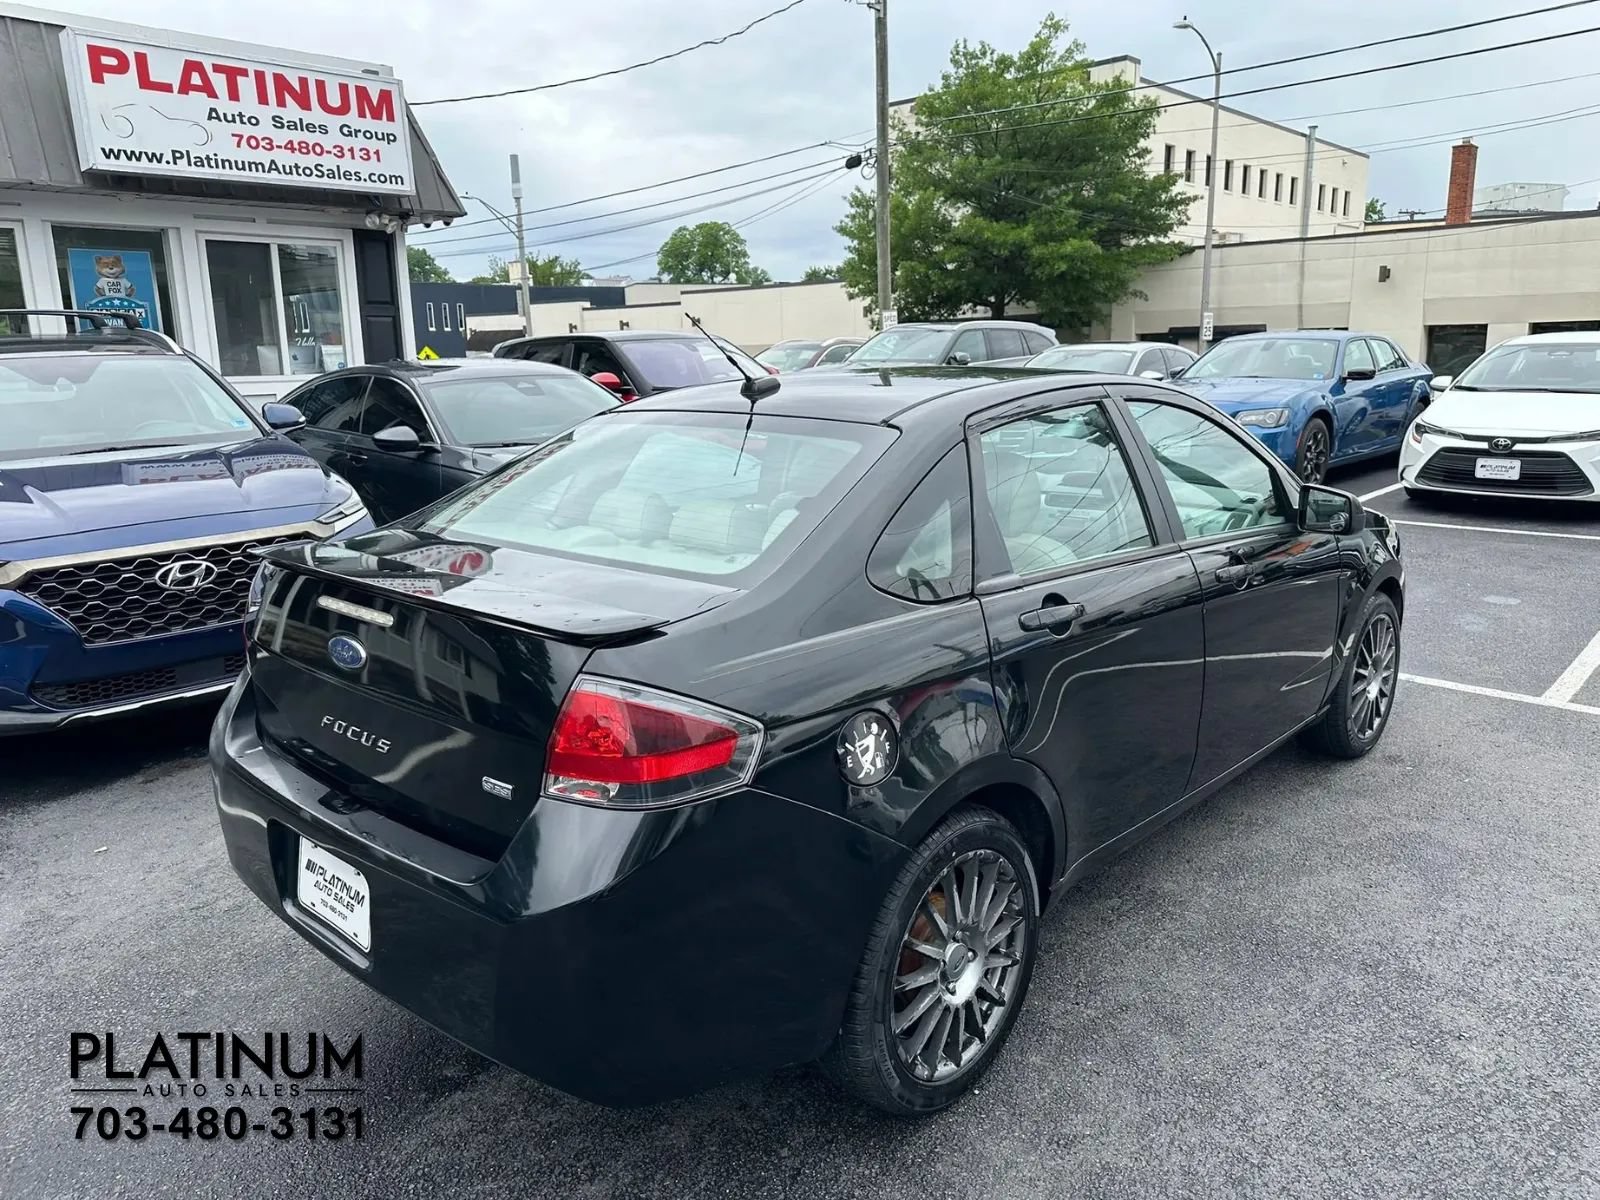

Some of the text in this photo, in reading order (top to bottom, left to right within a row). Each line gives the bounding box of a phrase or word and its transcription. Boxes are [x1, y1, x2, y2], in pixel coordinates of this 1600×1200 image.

[86, 43, 396, 123] PLATINUM
[206, 107, 398, 145] Auto Sales Group
[100, 147, 405, 187] www.PlatinumAutoSales.com
[231, 133, 382, 163] 703-480-3131
[321, 715, 392, 753] FOCUS
[847, 756, 853, 768] E
[314, 880, 355, 913] AUTO SALES
[316, 865, 365, 907] PLATINUM
